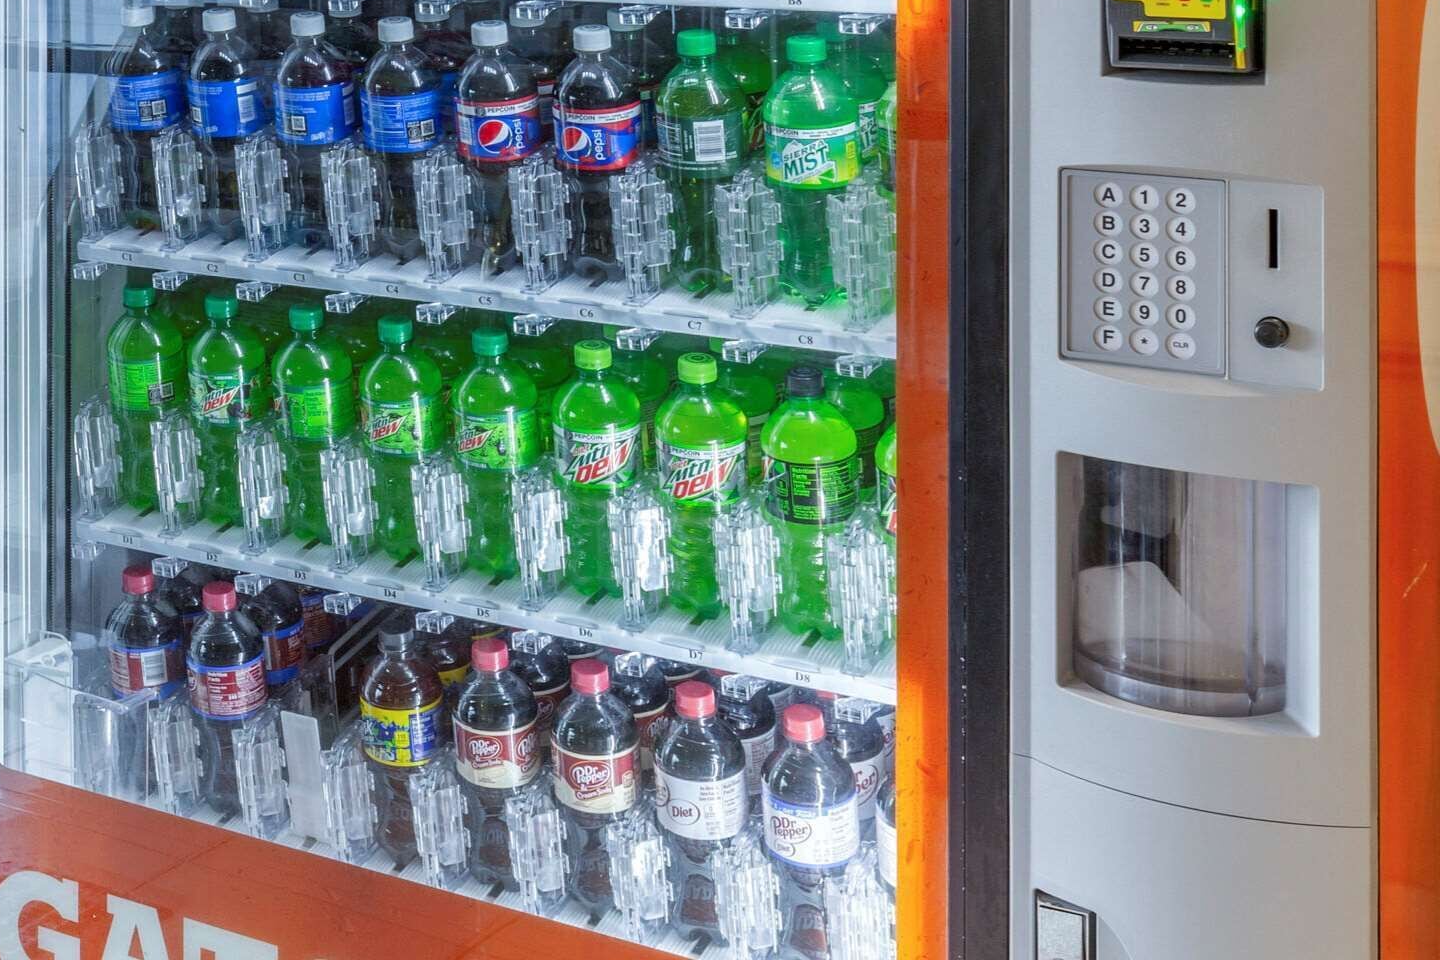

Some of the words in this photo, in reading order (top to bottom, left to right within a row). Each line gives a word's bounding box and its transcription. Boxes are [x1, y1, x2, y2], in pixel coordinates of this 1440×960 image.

[487, 106, 515, 114] PEPCOIN
[512, 118, 524, 156] pepsi
[592, 129, 607, 161] pepsi
[783, 141, 825, 161] SIERRA
[784, 145, 829, 179] MIST
[1102, 188, 1116, 202] A
[1140, 190, 1148, 204] 1
[1175, 193, 1187, 207] 2
[1102, 216, 1116, 230] B
[1139, 219, 1150, 233] 3
[1175, 222, 1187, 236] 4
[122, 252, 133, 262] C1
[1101, 244, 1116, 259] C
[1139, 248, 1150, 262] 5
[1175, 251, 1186, 265] 6
[207, 263, 219, 273] C2
[1102, 273, 1116, 287] D
[1139, 276, 1150, 291] 7
[1175, 280, 1186, 294] 8
[386, 285, 399, 295] C4
[478, 296, 492, 306] C5
[580, 309, 594, 319] C6
[1103, 301, 1115, 316] E
[1139, 305, 1150, 320] 9
[1175, 309, 1187, 324] 0
[688, 320, 702, 331] C7
[798, 334, 814, 345] C8
[1103, 330, 1114, 344] F
[1173, 341, 1189, 349] CLR
[123, 536, 133, 544] D1
[206, 553, 218, 562] D2
[294, 571, 306, 580] D3
[384, 589, 396, 599] D4
[476, 608, 490, 618] D5
[579, 628, 593, 638] D6
[689, 649, 704, 660] D7
[795, 672, 810, 683] D8
[573, 767, 609, 784] Pepper
[576, 790, 595, 799] Cream
[671, 806, 693, 817] Diet
[771, 816, 808, 840] Pepper
